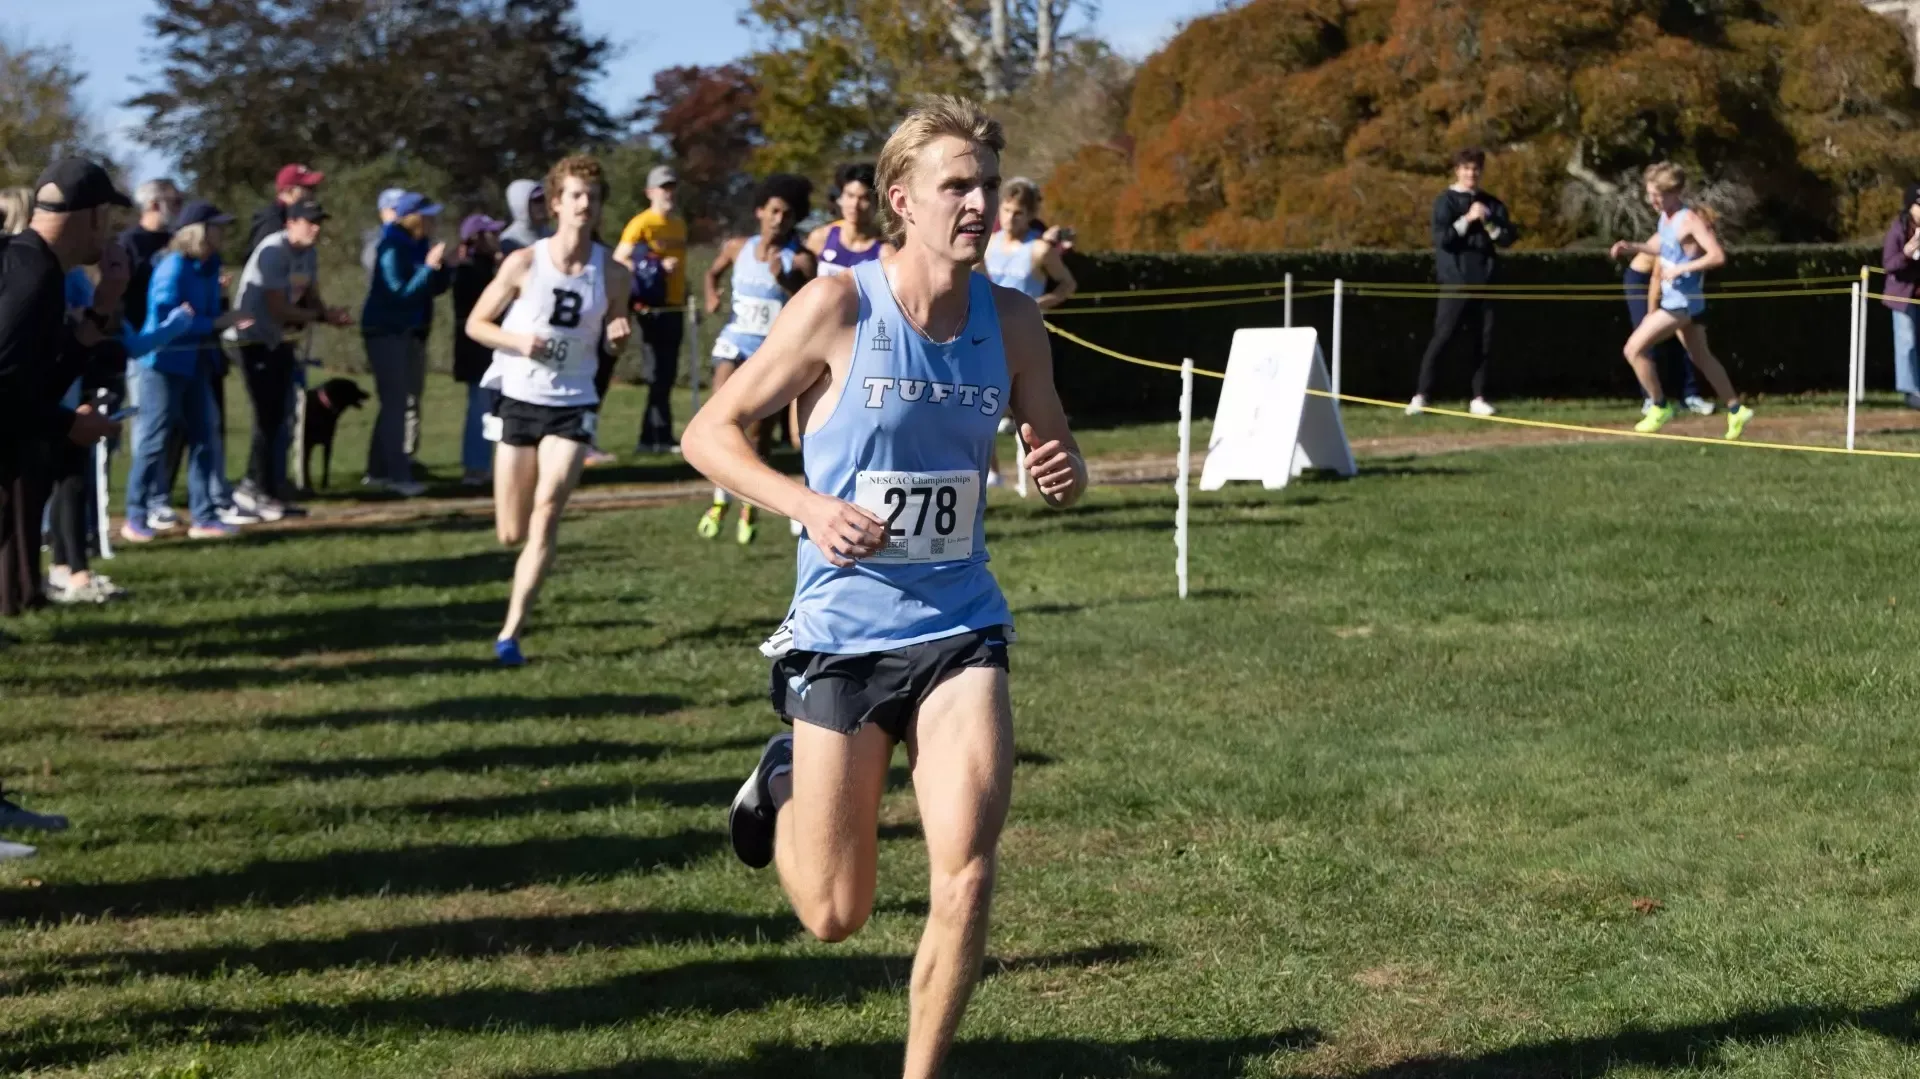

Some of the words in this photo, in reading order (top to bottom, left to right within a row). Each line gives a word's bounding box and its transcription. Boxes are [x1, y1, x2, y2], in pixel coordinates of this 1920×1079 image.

[548, 287, 583, 329] B
[863, 377, 1002, 417] TUFTS
[869, 476, 910, 485] NESCAC
[912, 475, 971, 487] Championships
[884, 486, 957, 537] 278
